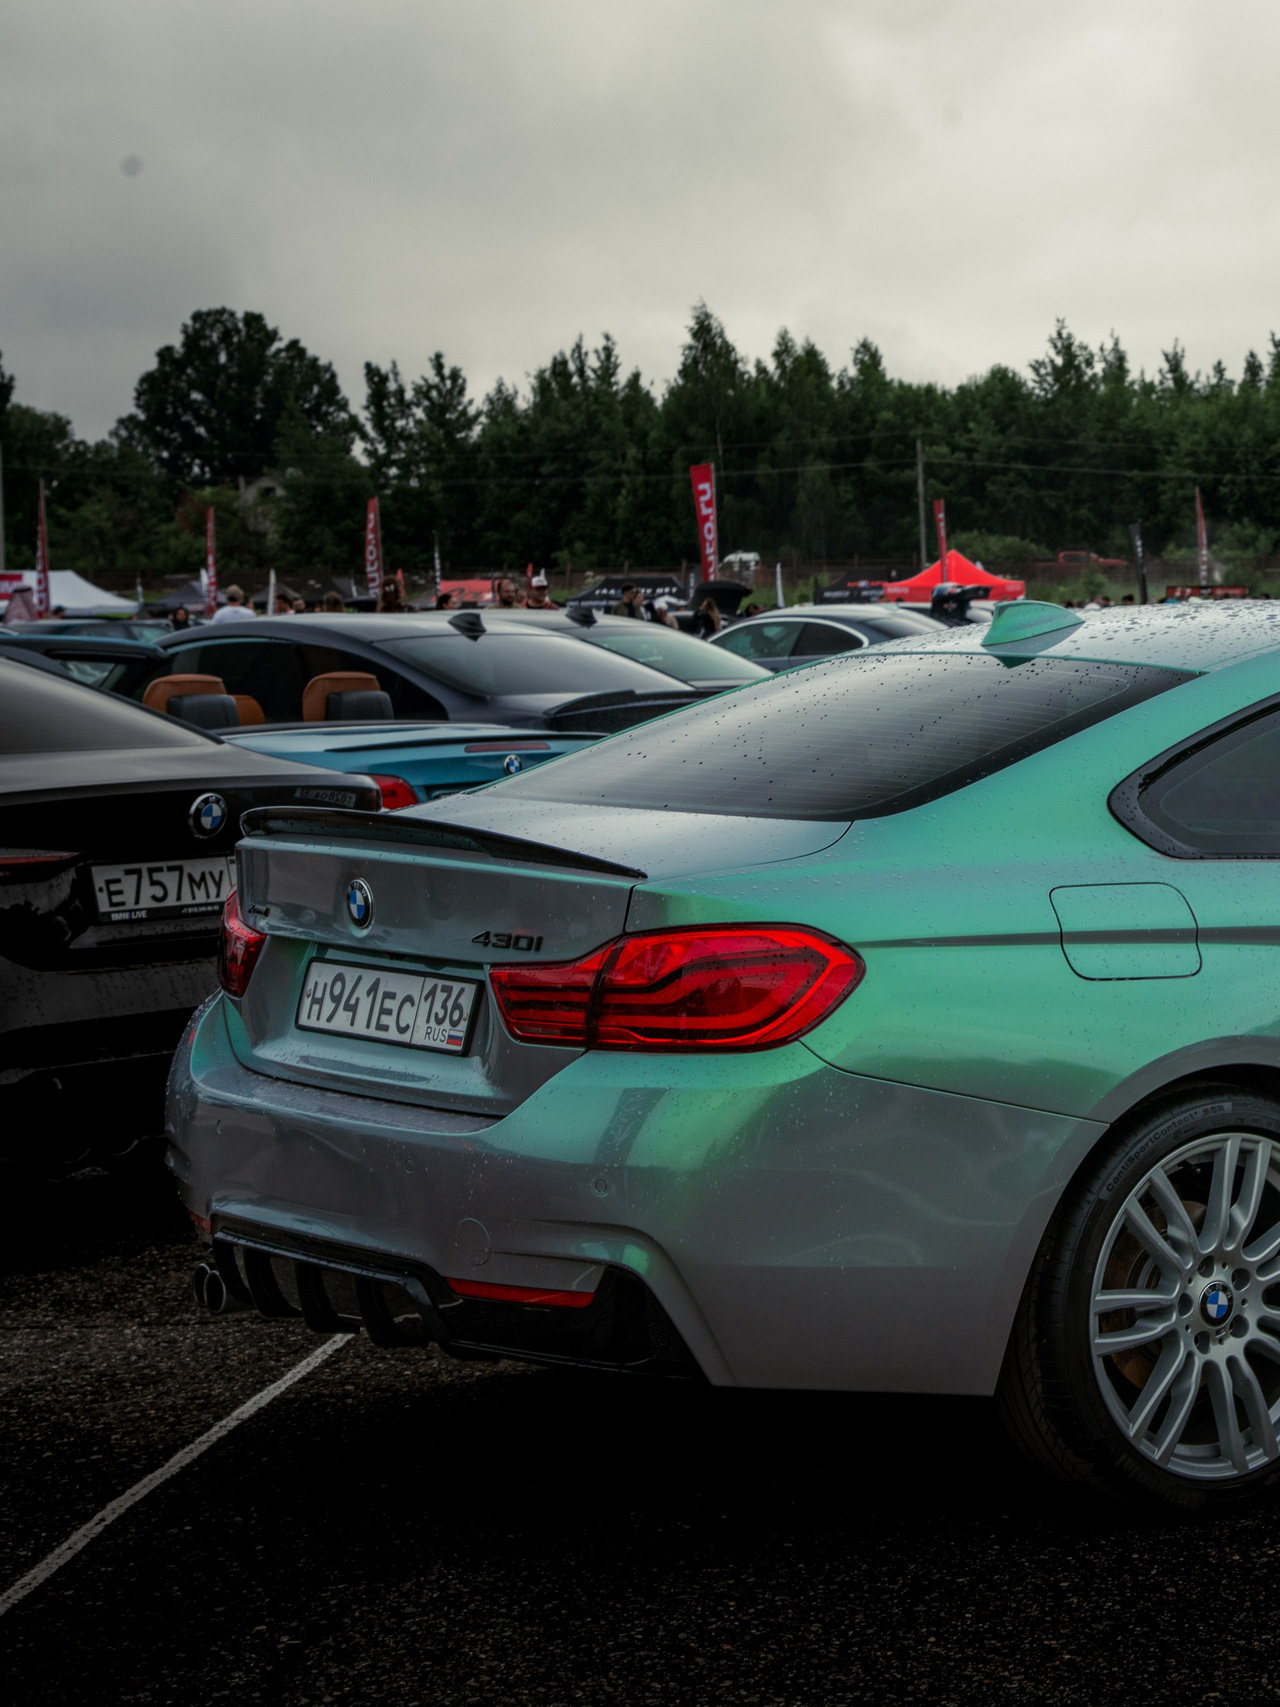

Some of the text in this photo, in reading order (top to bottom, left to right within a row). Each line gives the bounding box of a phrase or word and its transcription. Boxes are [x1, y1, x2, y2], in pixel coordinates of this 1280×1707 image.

[131, 910, 147, 919] LIVE
[424, 983, 465, 1028] 136
[424, 1027, 447, 1042] RUS
